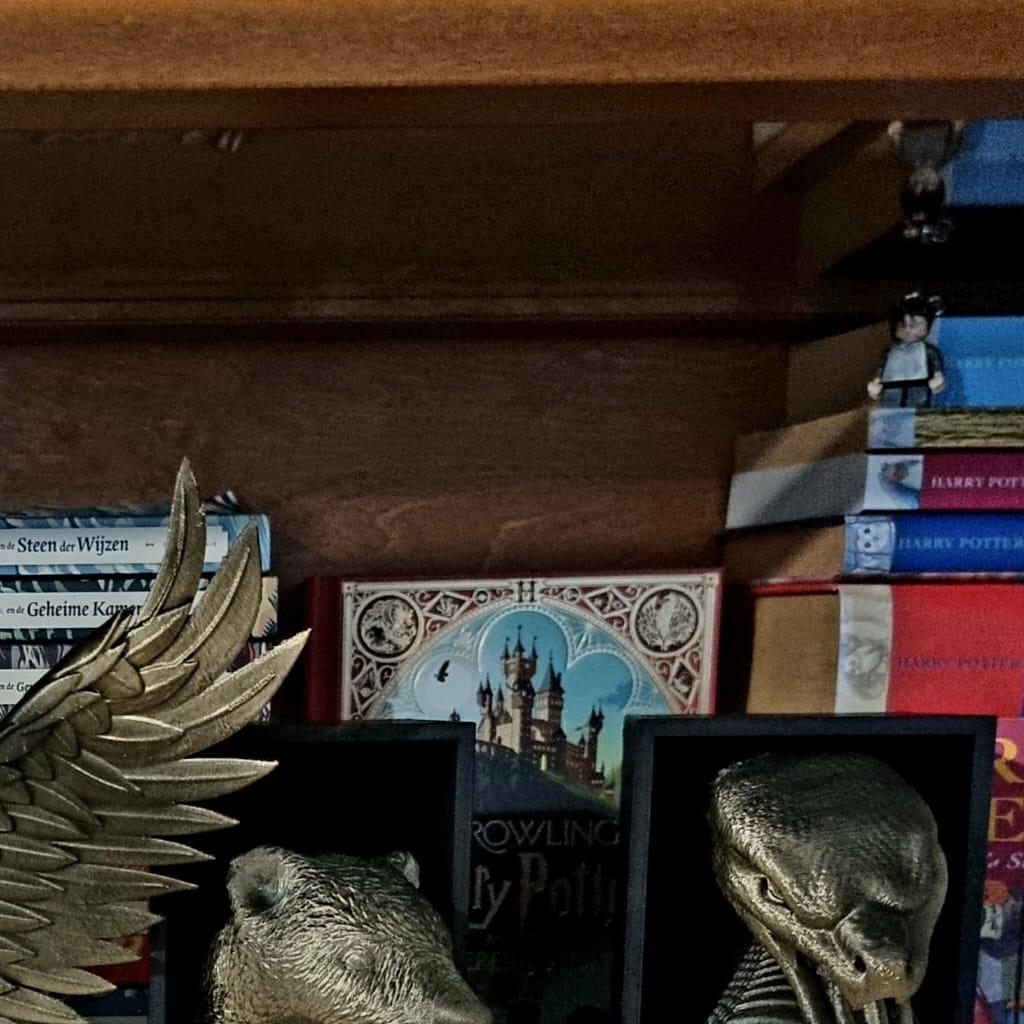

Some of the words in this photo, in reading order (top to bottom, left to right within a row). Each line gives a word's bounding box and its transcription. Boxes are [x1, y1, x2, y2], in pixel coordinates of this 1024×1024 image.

[931, 477, 984, 488] HARRY
[17, 536, 57, 553] Steen
[59, 540, 76, 553] der
[77, 536, 129, 556] Wijzen
[898, 537, 956, 549] HARRY
[27, 601, 92, 617] Geheime
[897, 657, 948, 669] HARRY
